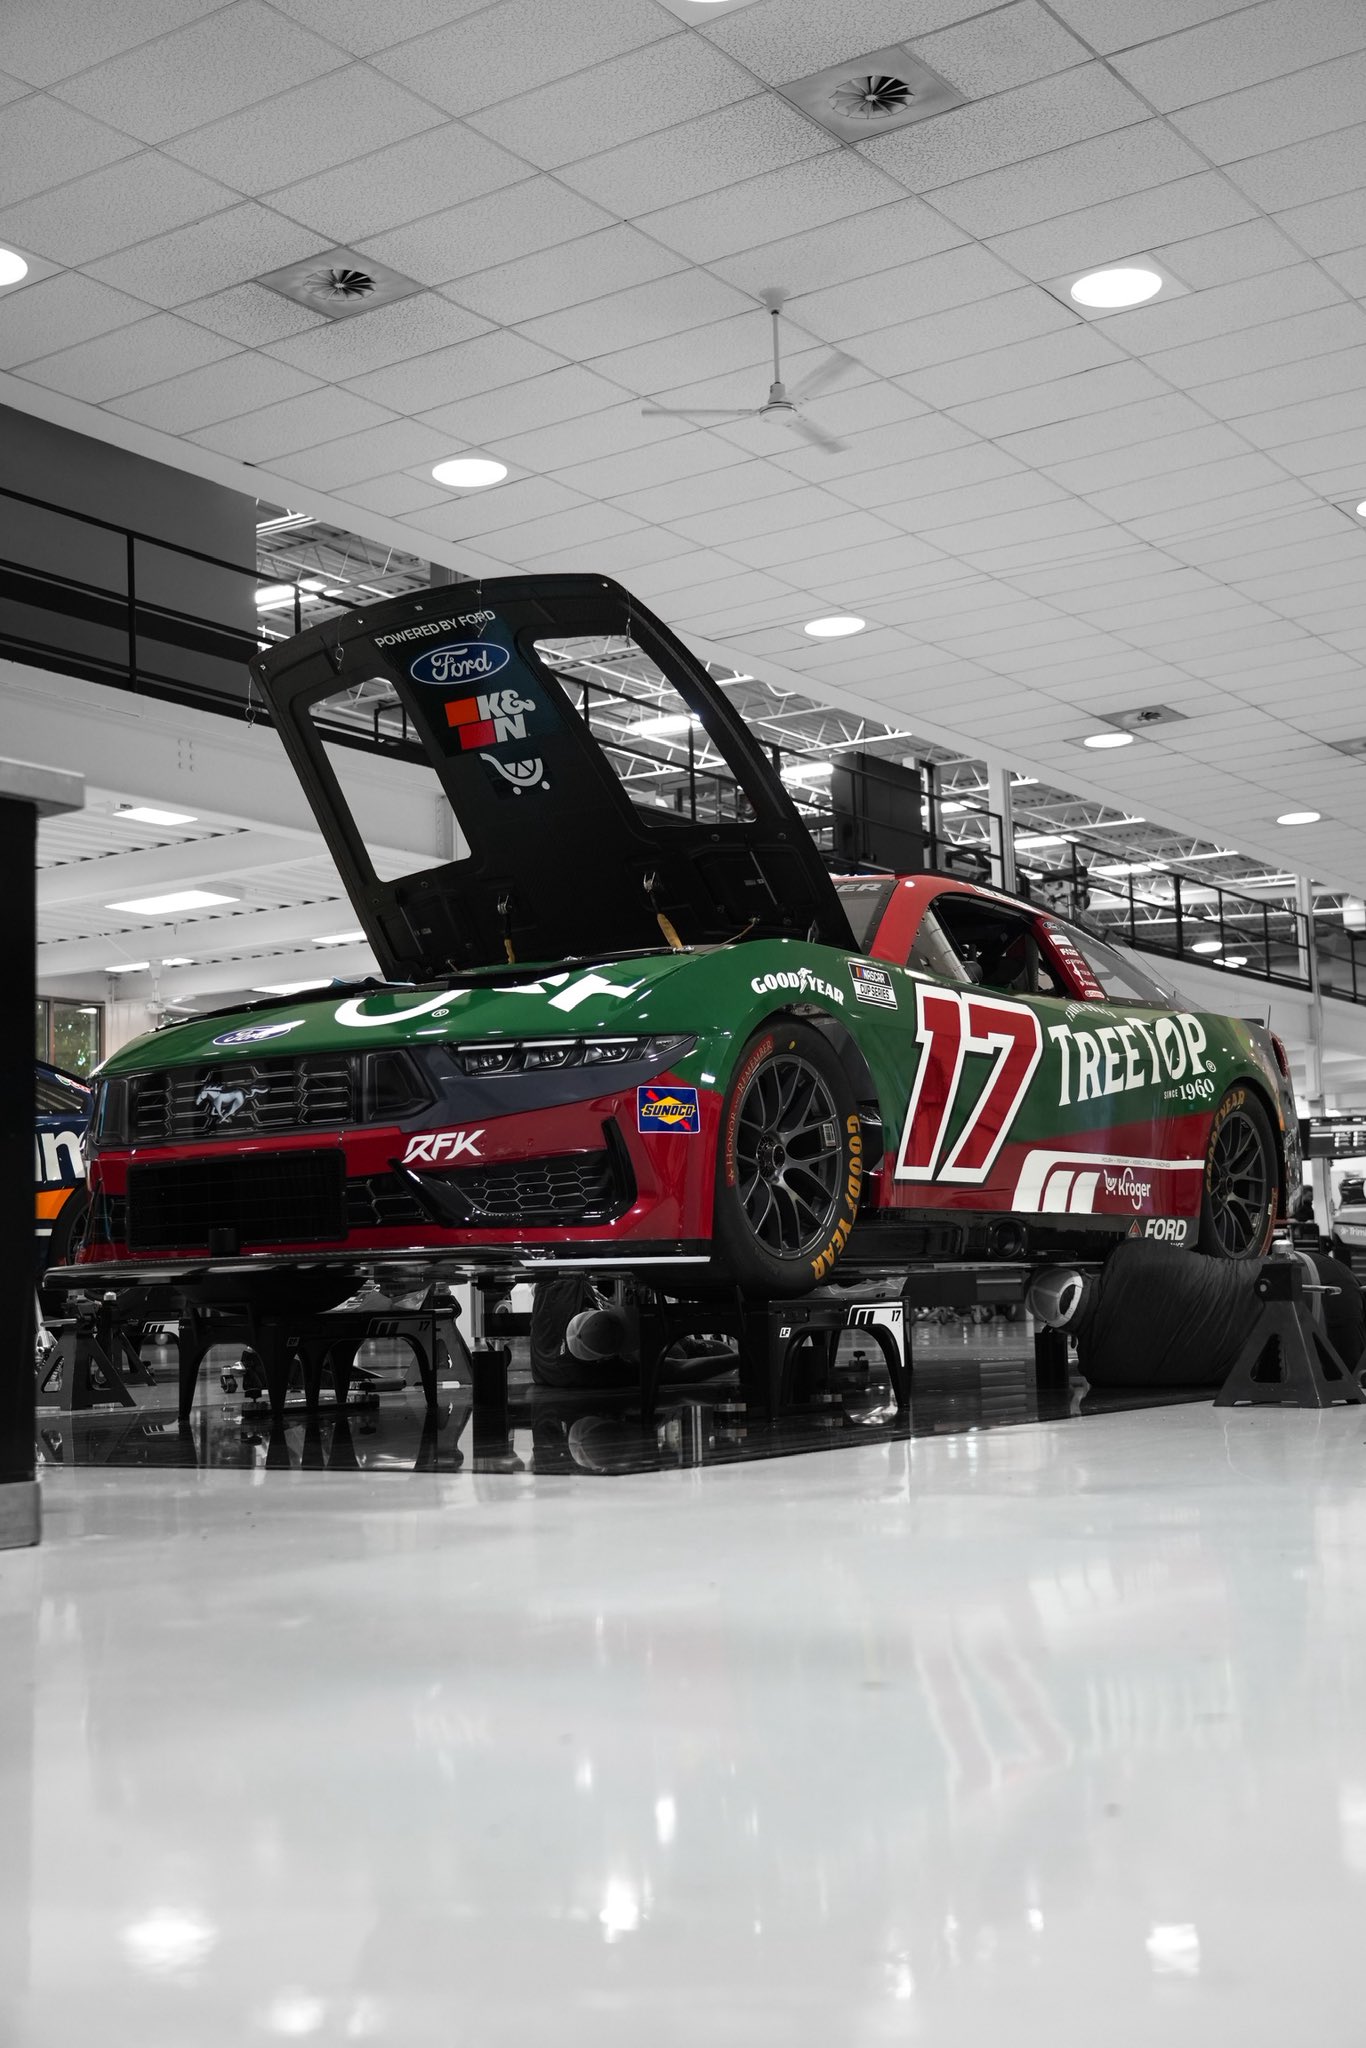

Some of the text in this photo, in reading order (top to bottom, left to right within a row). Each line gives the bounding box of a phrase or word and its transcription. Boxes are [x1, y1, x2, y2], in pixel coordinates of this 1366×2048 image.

[374, 609, 497, 649] POWERED BY FORD
[431, 647, 492, 682] Ford
[750, 967, 845, 1007] GOODYEAR
[863, 967, 886, 985] NASCAR
[860, 983, 890, 1000] CUP SERIES
[894, 982, 1043, 1185] 17
[1163, 1077, 1215, 1102] SINCE 1960
[644, 1104, 694, 1117] SUNOCO
[728, 1111, 739, 1167] HONOR
[737, 1039, 774, 1094] REMEMBER
[401, 1129, 486, 1164] RFK
[811, 1113, 863, 1281] GOODYEAR
[1118, 1167, 1151, 1211] Kroger
[1144, 1218, 1187, 1241] FORD
[418, 1320, 430, 1332] 17
[891, 1310, 902, 1322] 17
[780, 1328, 790, 1338] LF
